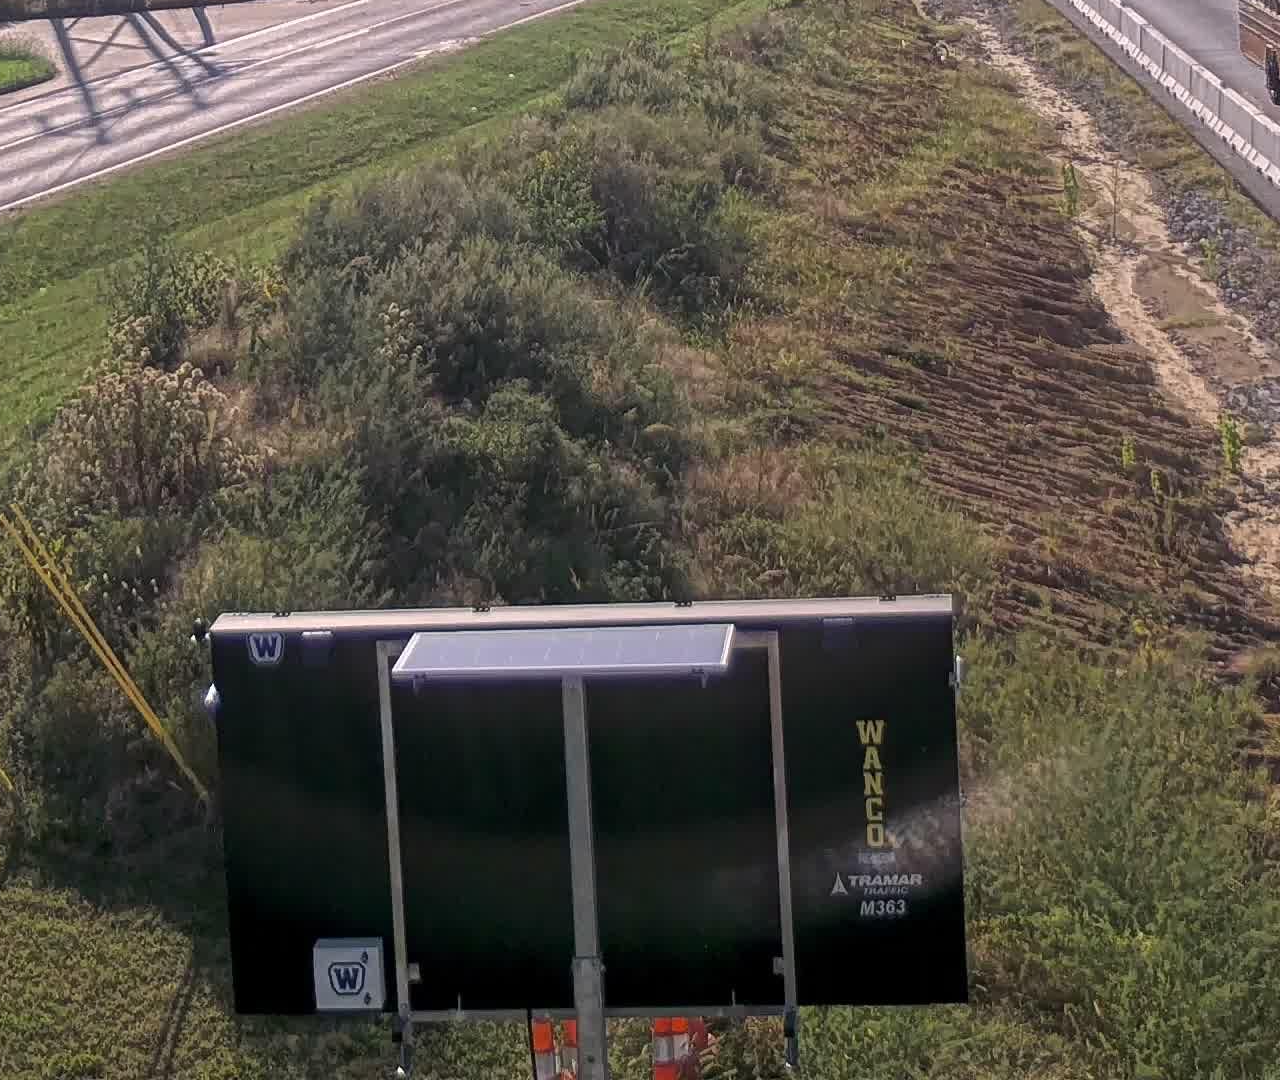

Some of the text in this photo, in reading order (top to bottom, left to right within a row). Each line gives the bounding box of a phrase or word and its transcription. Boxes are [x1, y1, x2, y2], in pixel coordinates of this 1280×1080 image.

[253, 635, 279, 658] W
[856, 719, 885, 848] WANCO
[848, 873, 923, 887] TRAMAR
[863, 886, 909, 896] TRAFFIC
[860, 899, 906, 916] M363
[334, 967, 360, 990] W
